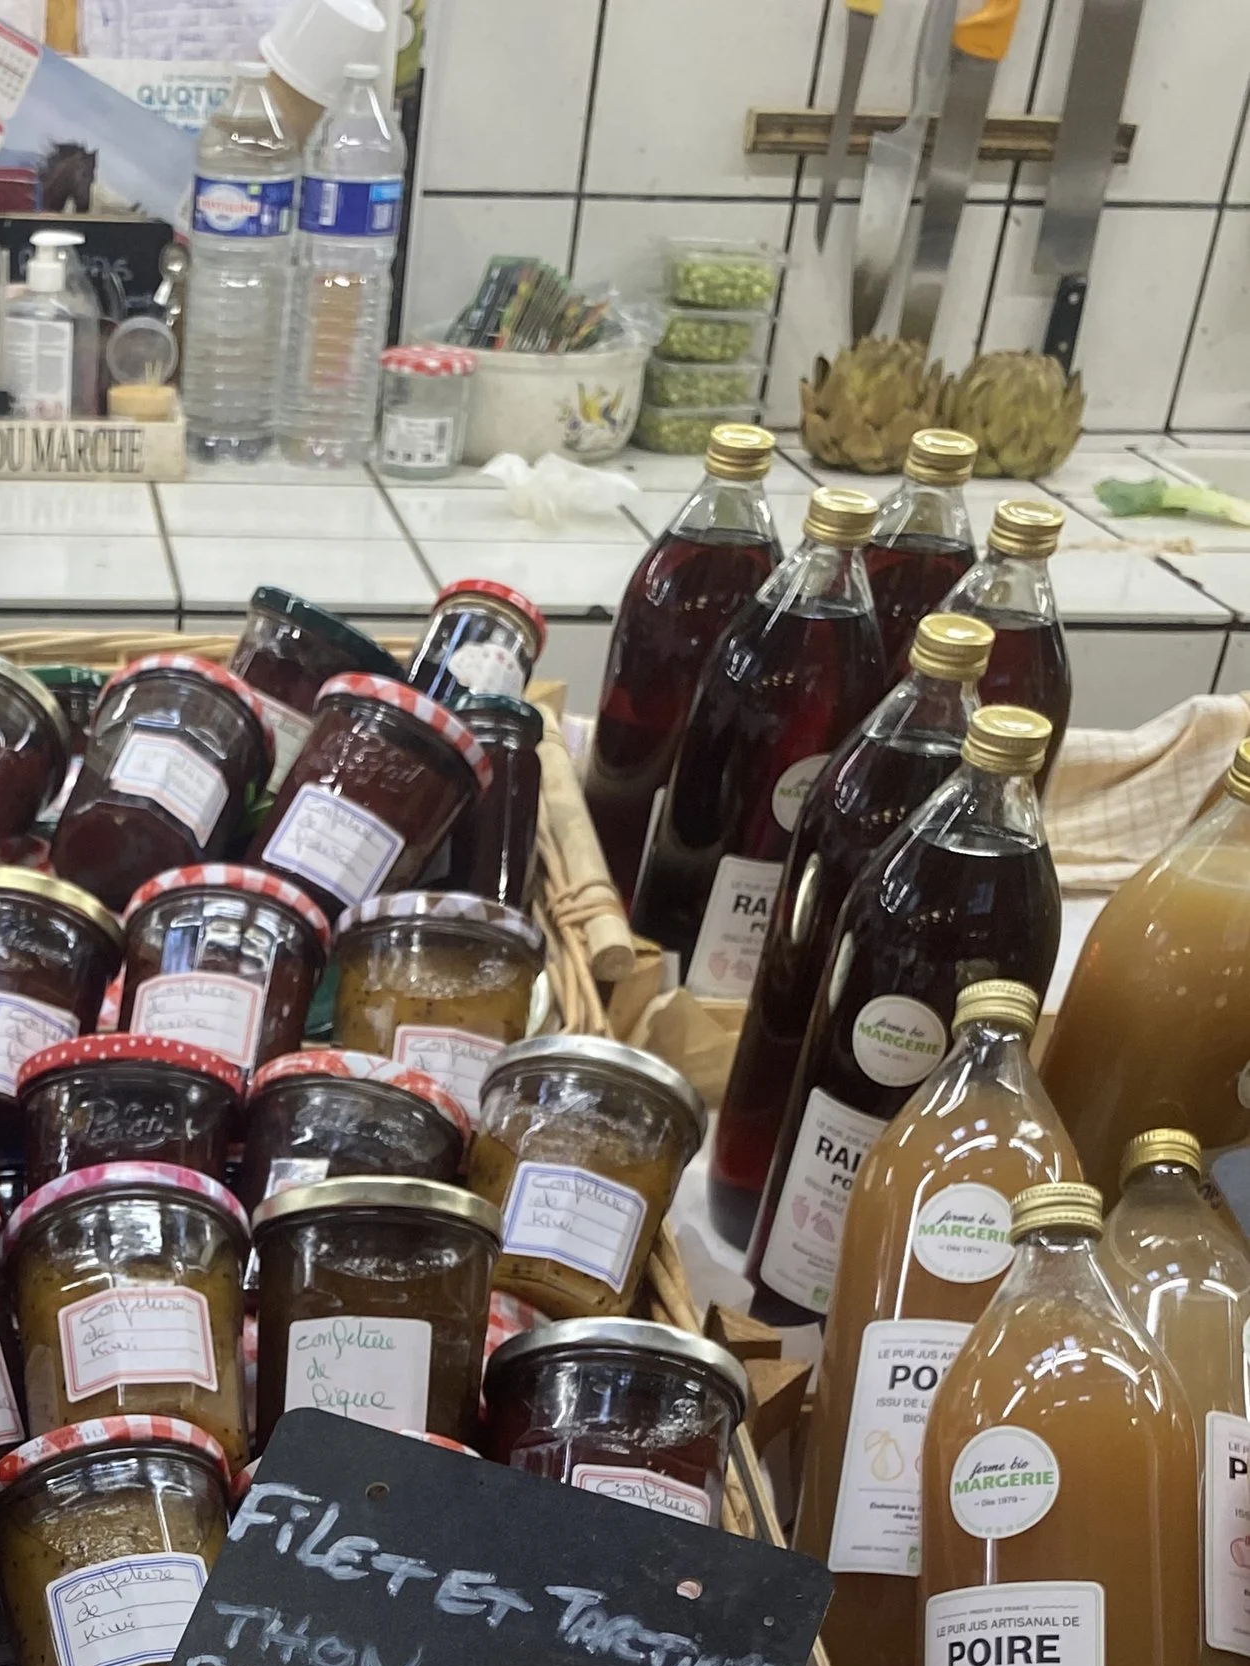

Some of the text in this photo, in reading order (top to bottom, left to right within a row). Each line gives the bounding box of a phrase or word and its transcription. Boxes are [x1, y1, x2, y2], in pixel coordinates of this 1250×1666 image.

[31, 428, 146, 474] MARCHE
[857, 1021, 943, 1057] MARGERIE
[814, 1136, 864, 1174] RAI
[935, 1210, 997, 1226] ferme bio
[306, 1357, 331, 1380] de
[888, 1364, 942, 1392] PO
[969, 1456, 1030, 1481] ferme bio
[953, 1471, 1055, 1496] MARGERIE
[434, 1568, 534, 1627] ET
[936, 1616, 1081, 1638] LE PUR JUS ARTISANAL DE
